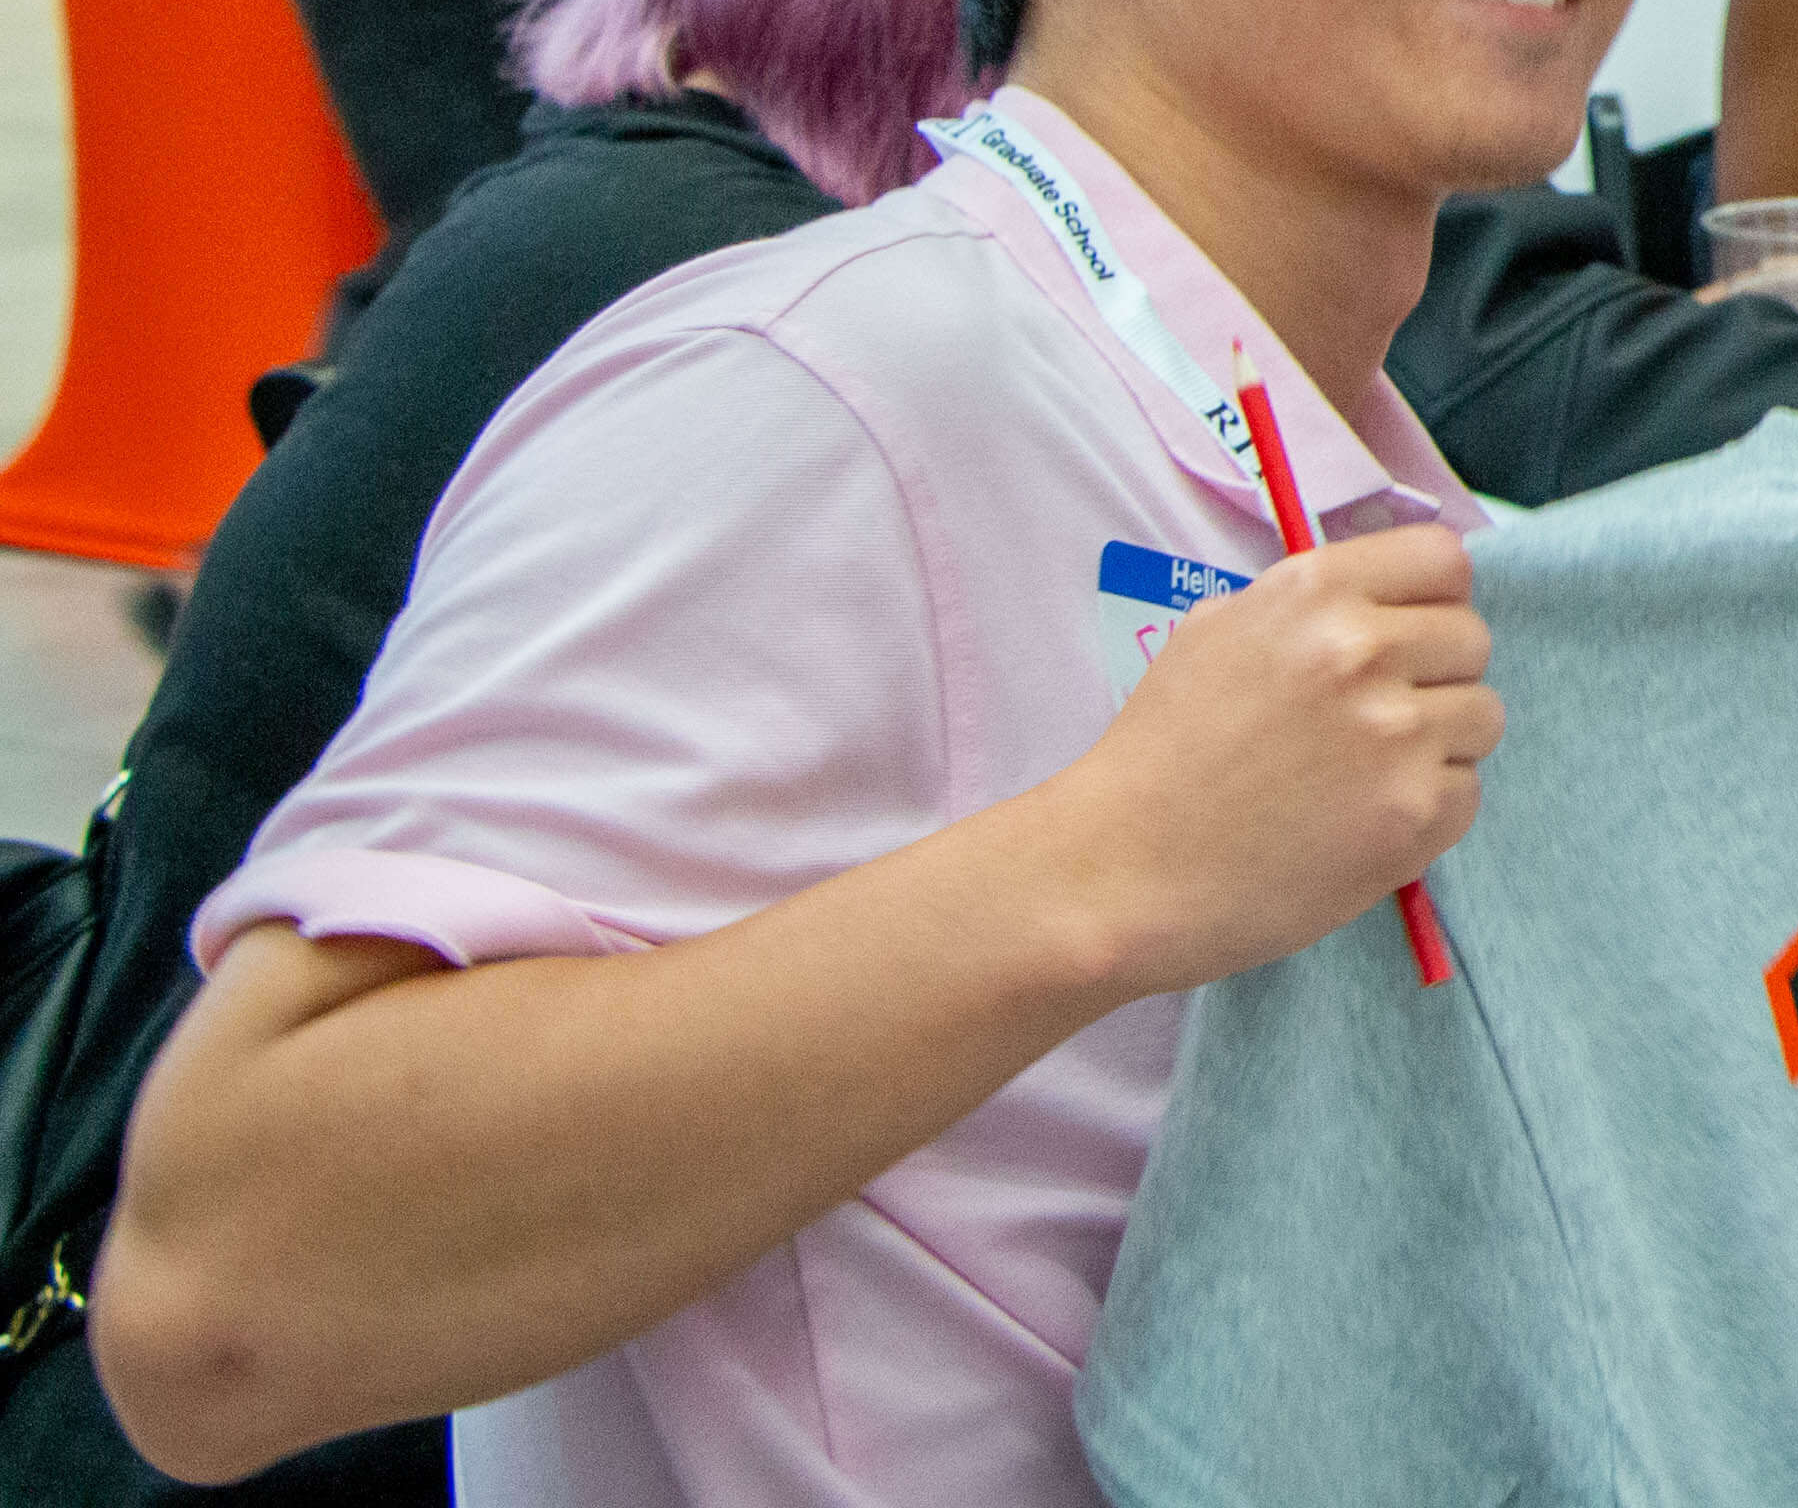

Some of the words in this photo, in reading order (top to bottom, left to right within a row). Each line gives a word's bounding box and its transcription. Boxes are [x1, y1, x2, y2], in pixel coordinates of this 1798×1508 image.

[980, 127, 1061, 203] Graduate
[1054, 200, 1116, 282] School
[1170, 558, 1231, 598] Hello
